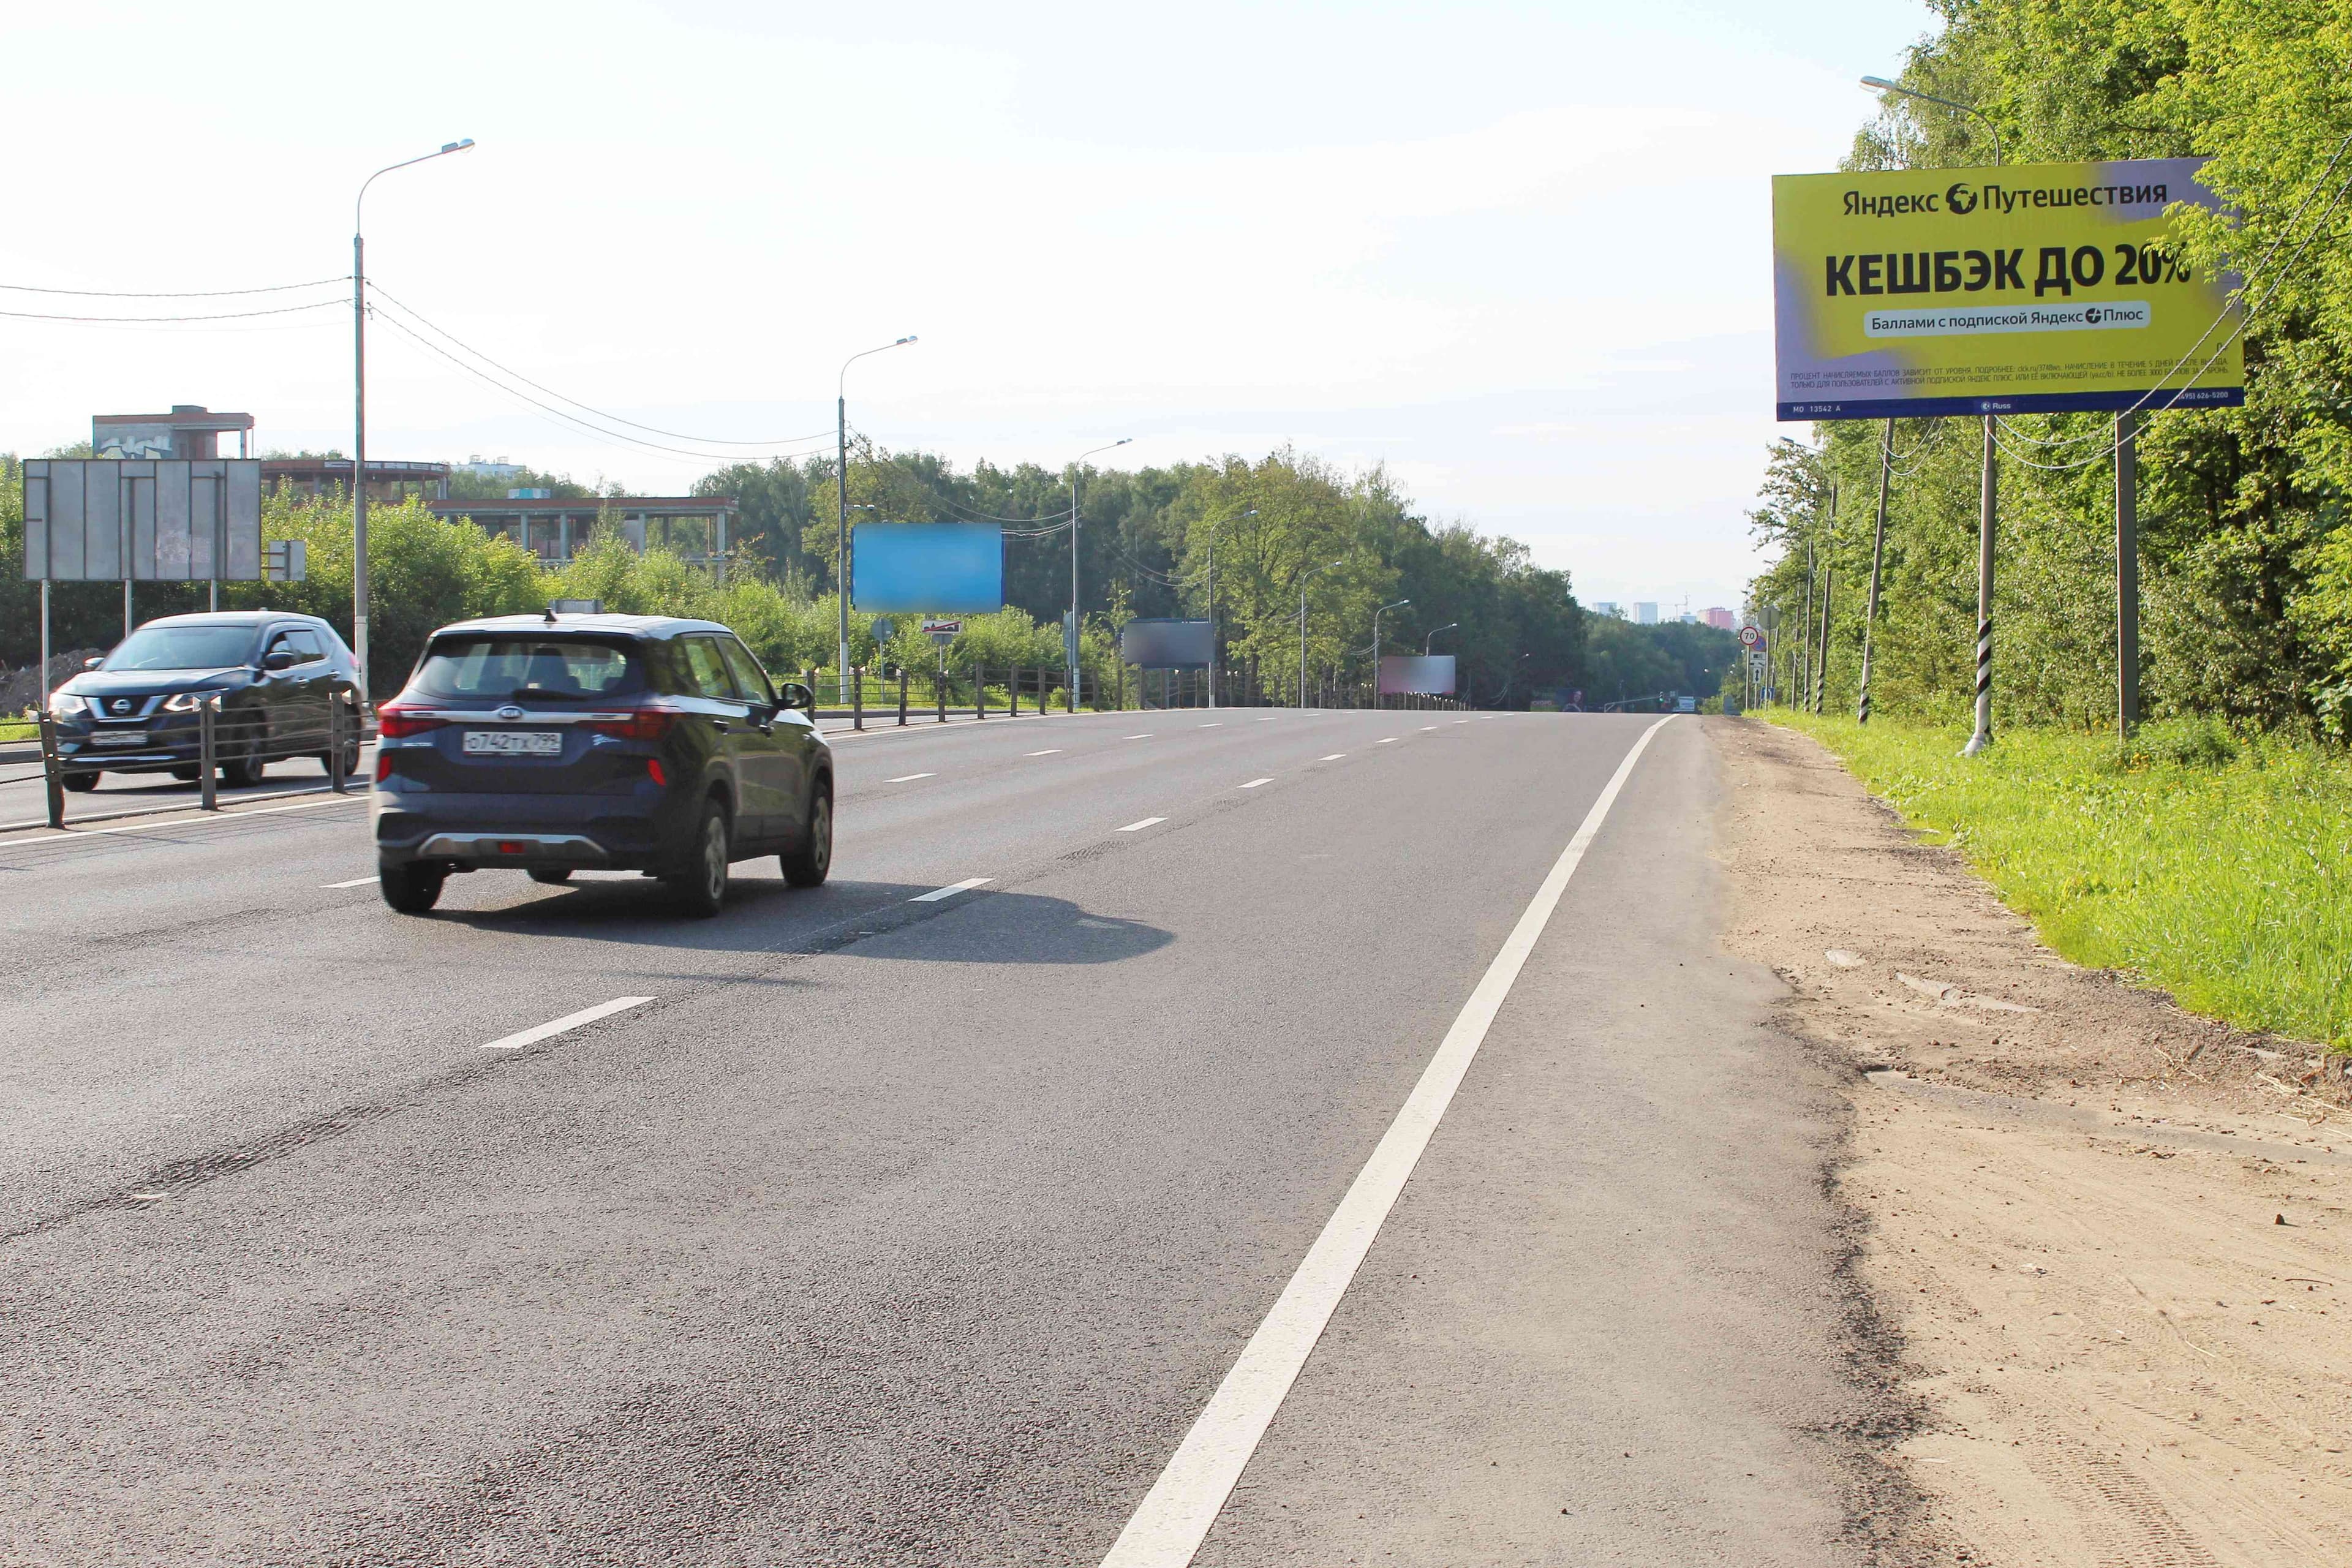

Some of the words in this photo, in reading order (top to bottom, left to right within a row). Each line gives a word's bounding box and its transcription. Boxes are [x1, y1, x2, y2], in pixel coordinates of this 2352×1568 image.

[1844, 191, 1939, 217] Яндекс
[1983, 184, 2167, 214] Путешествия
[1826, 249, 2026, 296] КЕШБЭК
[2034, 245, 2105, 297] ДО
[2115, 241, 2191, 285] 20%
[1872, 317, 1935, 330] Баллами
[1939, 318, 1946, 327] с
[1950, 312, 2027, 328] подпиской
[2031, 312, 2083, 325] Яндекс
[2104, 309, 2144, 321] Плюс
[2155, 359, 2173, 368] ДНЕЙ
[1831, 378, 1883, 387] ПОЛЬЗОВАТЕЛЕЙ
[1927, 375, 1966, 384] ПОДПИСКОЙ
[2040, 371, 2087, 380] ВКЛЮЧАЮЩЕЙ
